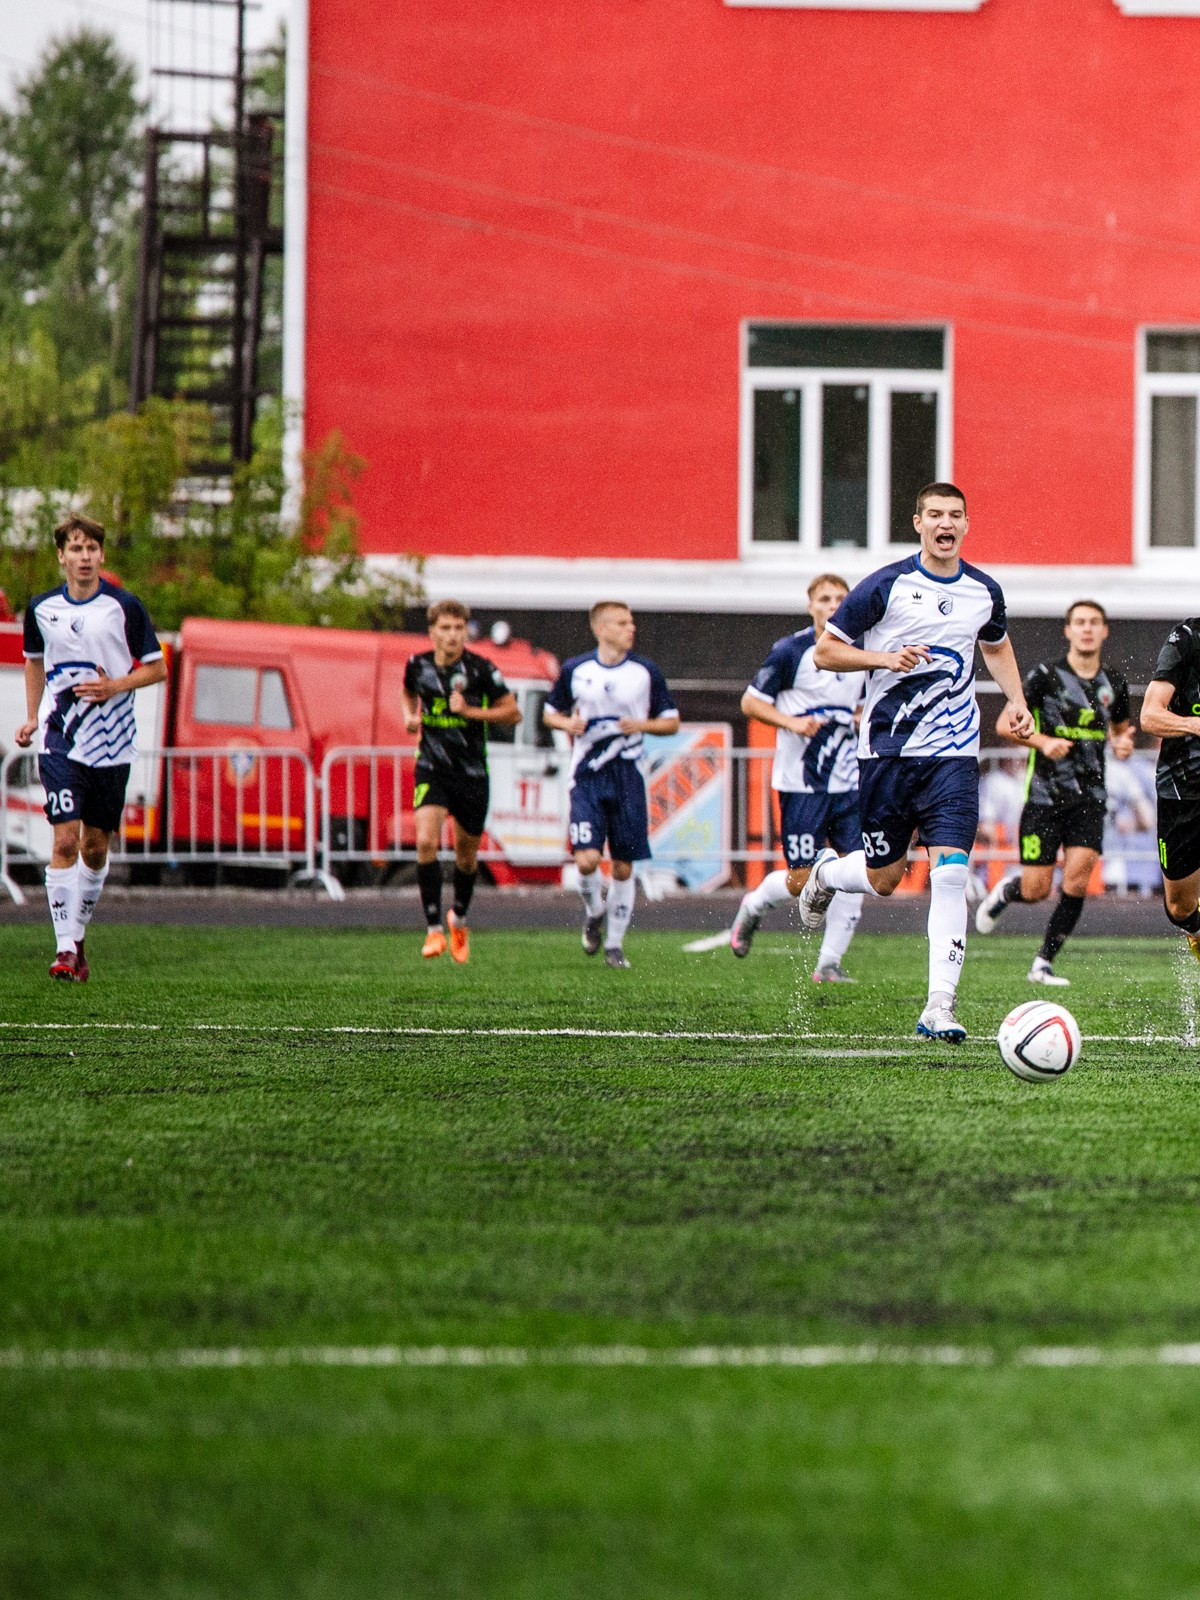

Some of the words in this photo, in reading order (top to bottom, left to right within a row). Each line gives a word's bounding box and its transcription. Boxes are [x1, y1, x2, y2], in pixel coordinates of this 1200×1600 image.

[48, 788, 75, 816] 26
[569, 821, 592, 845] 95
[862, 831, 890, 858] 83
[787, 833, 815, 861] 38
[948, 950, 963, 966] 83
